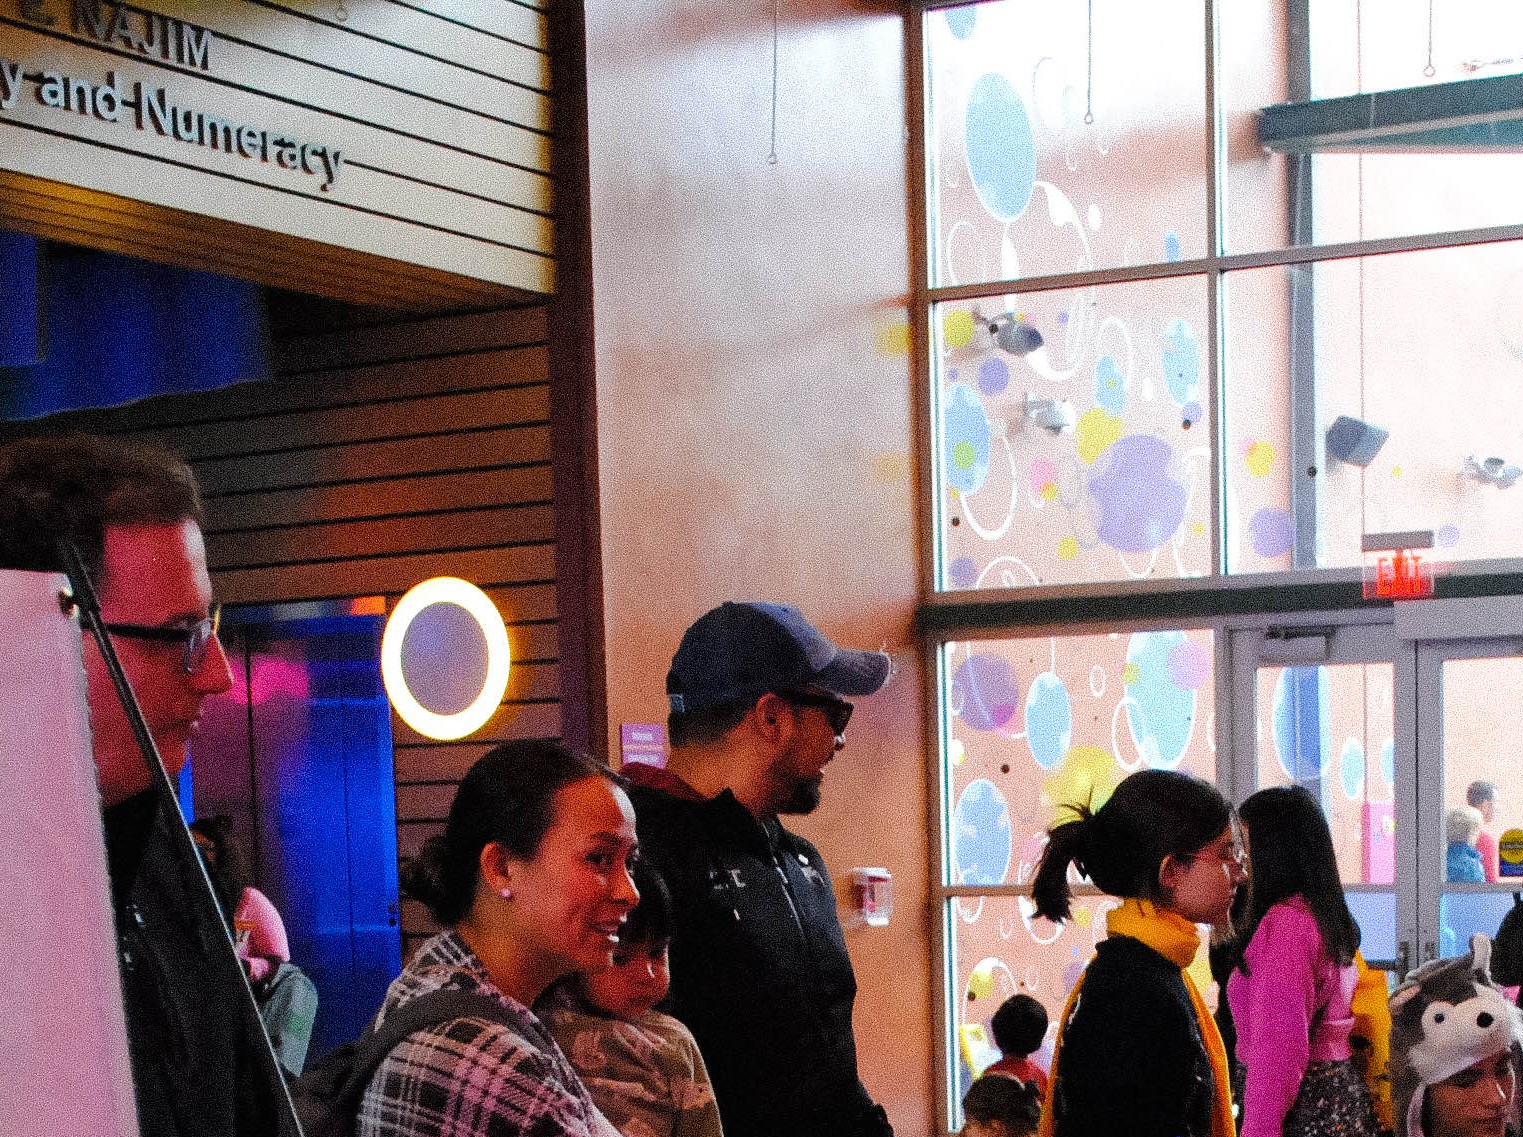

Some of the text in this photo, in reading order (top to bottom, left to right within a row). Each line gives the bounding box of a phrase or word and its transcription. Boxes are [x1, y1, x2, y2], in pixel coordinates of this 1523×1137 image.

[36, 71, 122, 122] and
[132, 82, 343, 192] Numeracy
[1377, 555, 1422, 597] EXIT
